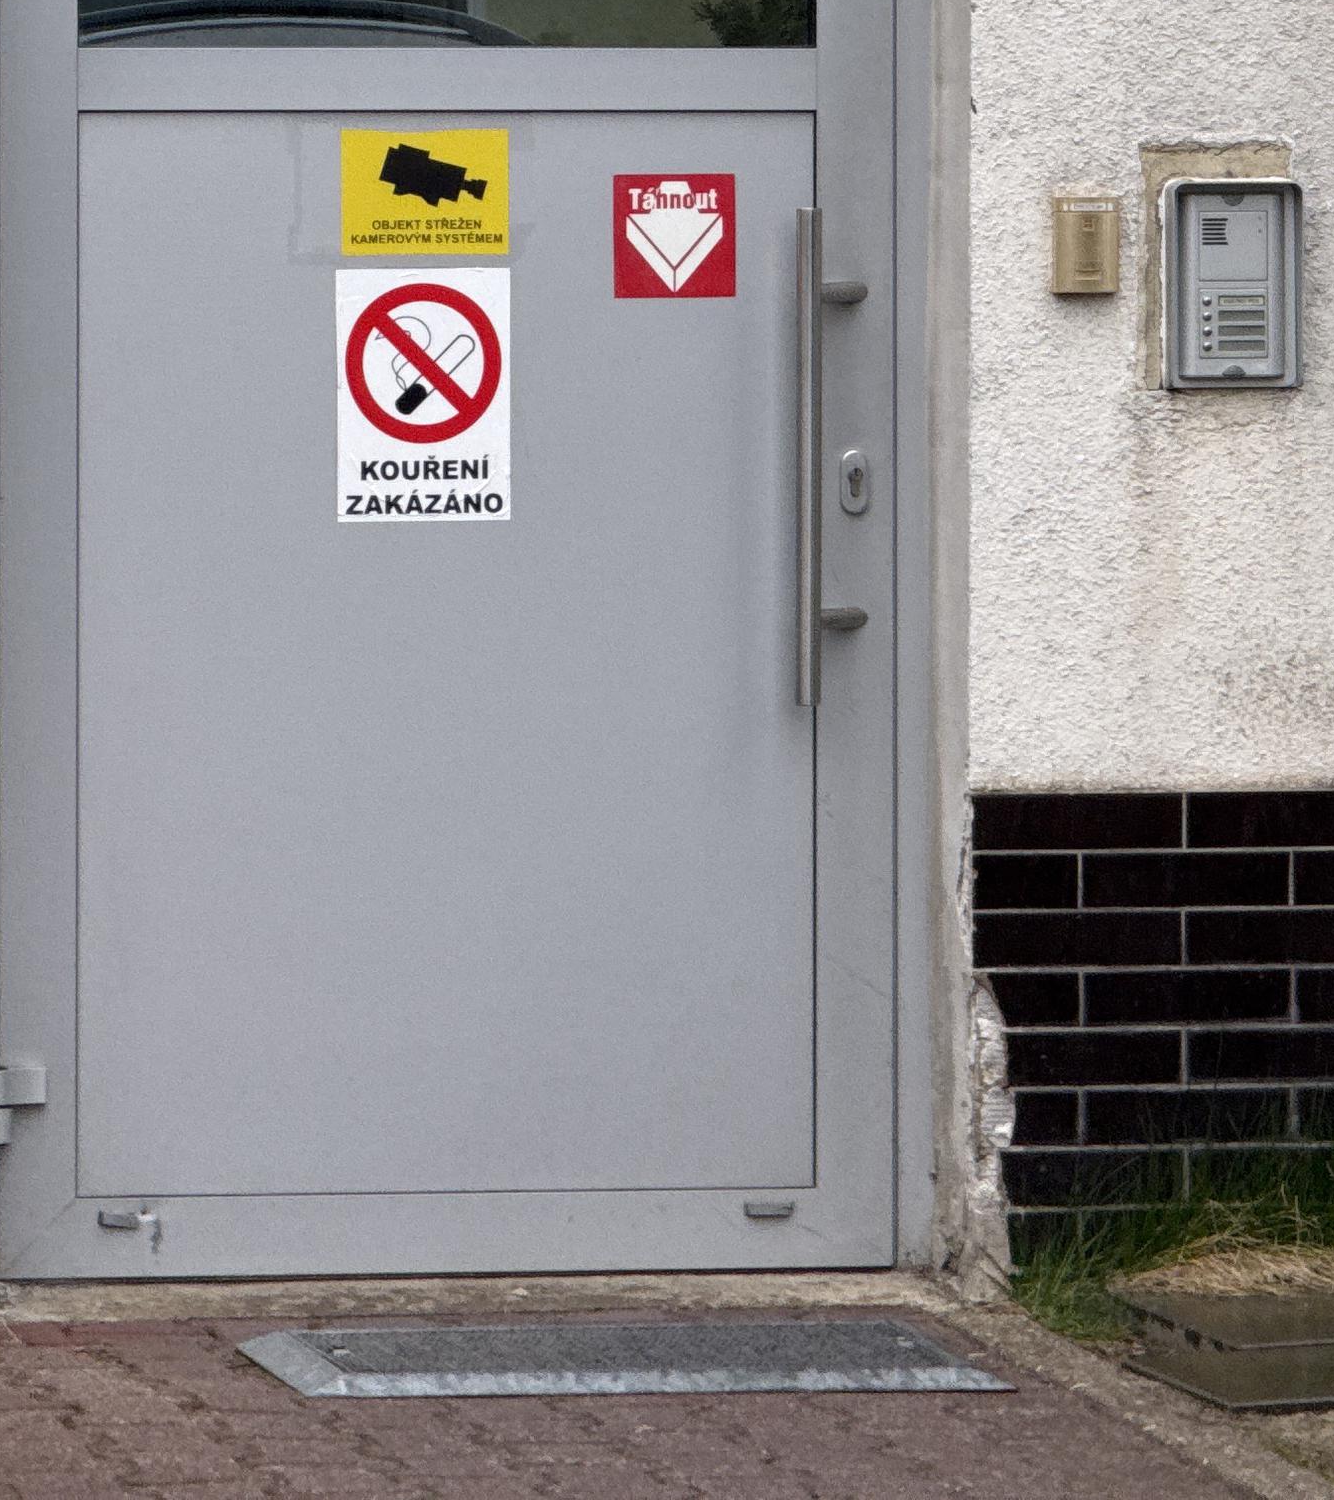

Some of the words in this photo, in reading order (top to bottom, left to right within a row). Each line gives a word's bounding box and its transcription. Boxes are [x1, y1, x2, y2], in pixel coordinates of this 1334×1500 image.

[628, 186, 718, 211] Táhnout
[371, 219, 422, 231] OBJEKT
[425, 217, 483, 231] STŘEŽEN
[351, 232, 432, 245] KAMEROVÝM
[435, 231, 504, 245] SYSTÉMEM
[360, 454, 490, 481] KOUŘENÍ
[345, 488, 504, 515] ZAKÁZÁNO
